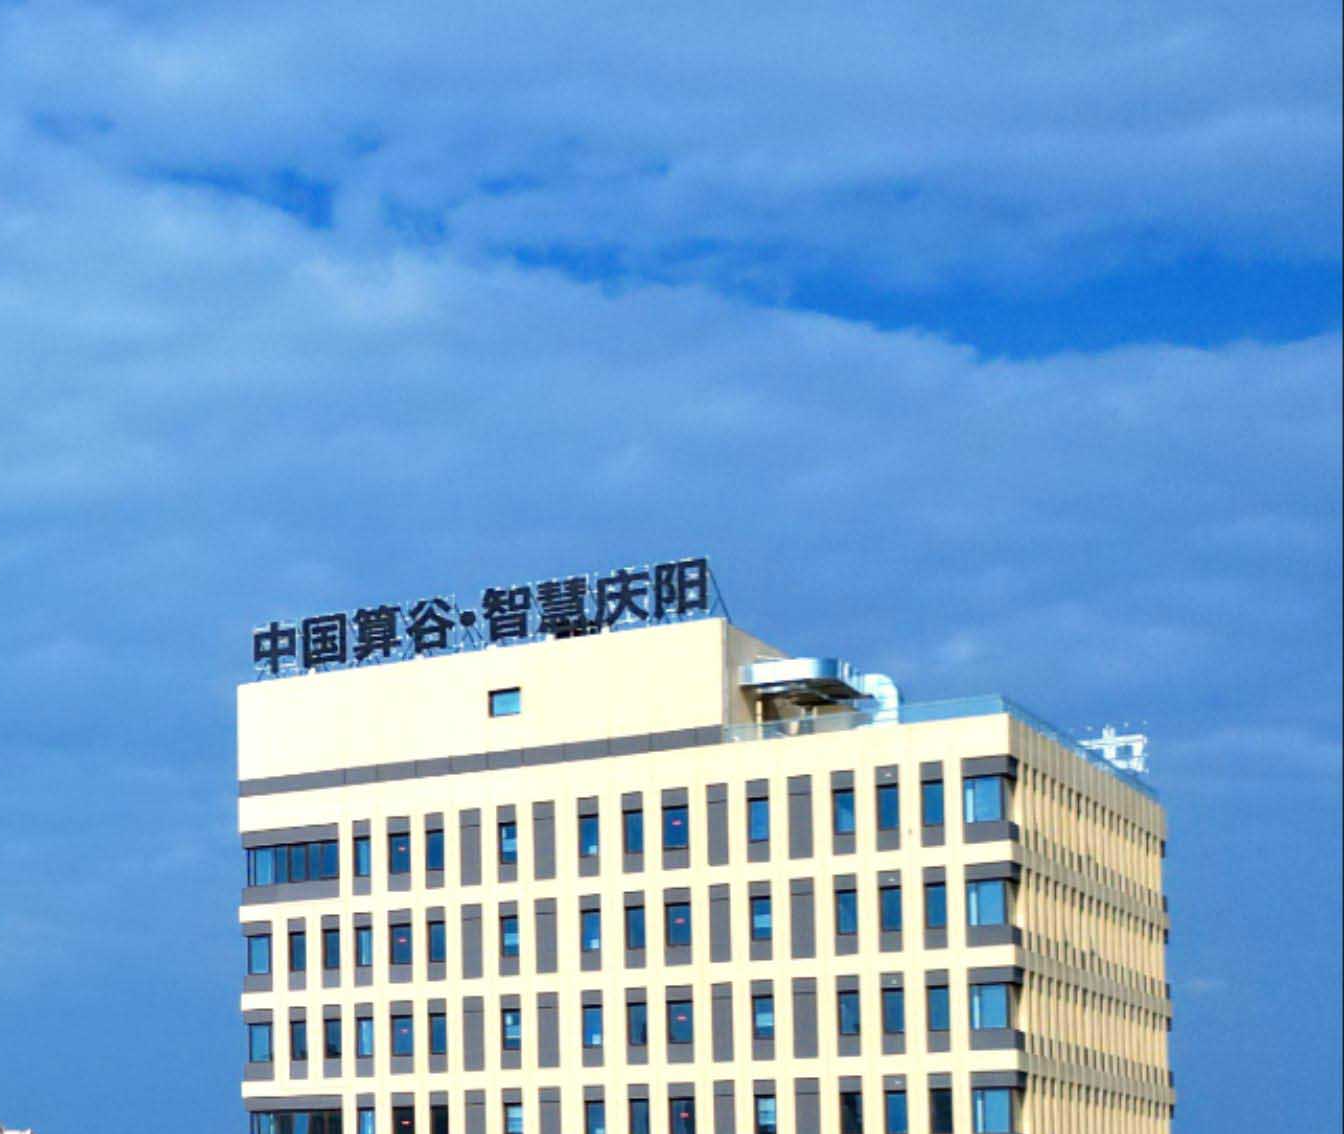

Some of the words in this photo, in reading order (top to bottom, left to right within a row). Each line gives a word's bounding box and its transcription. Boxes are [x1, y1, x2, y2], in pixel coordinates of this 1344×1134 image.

[253, 557, 708, 675] 中国算谷·智慧庆阳
